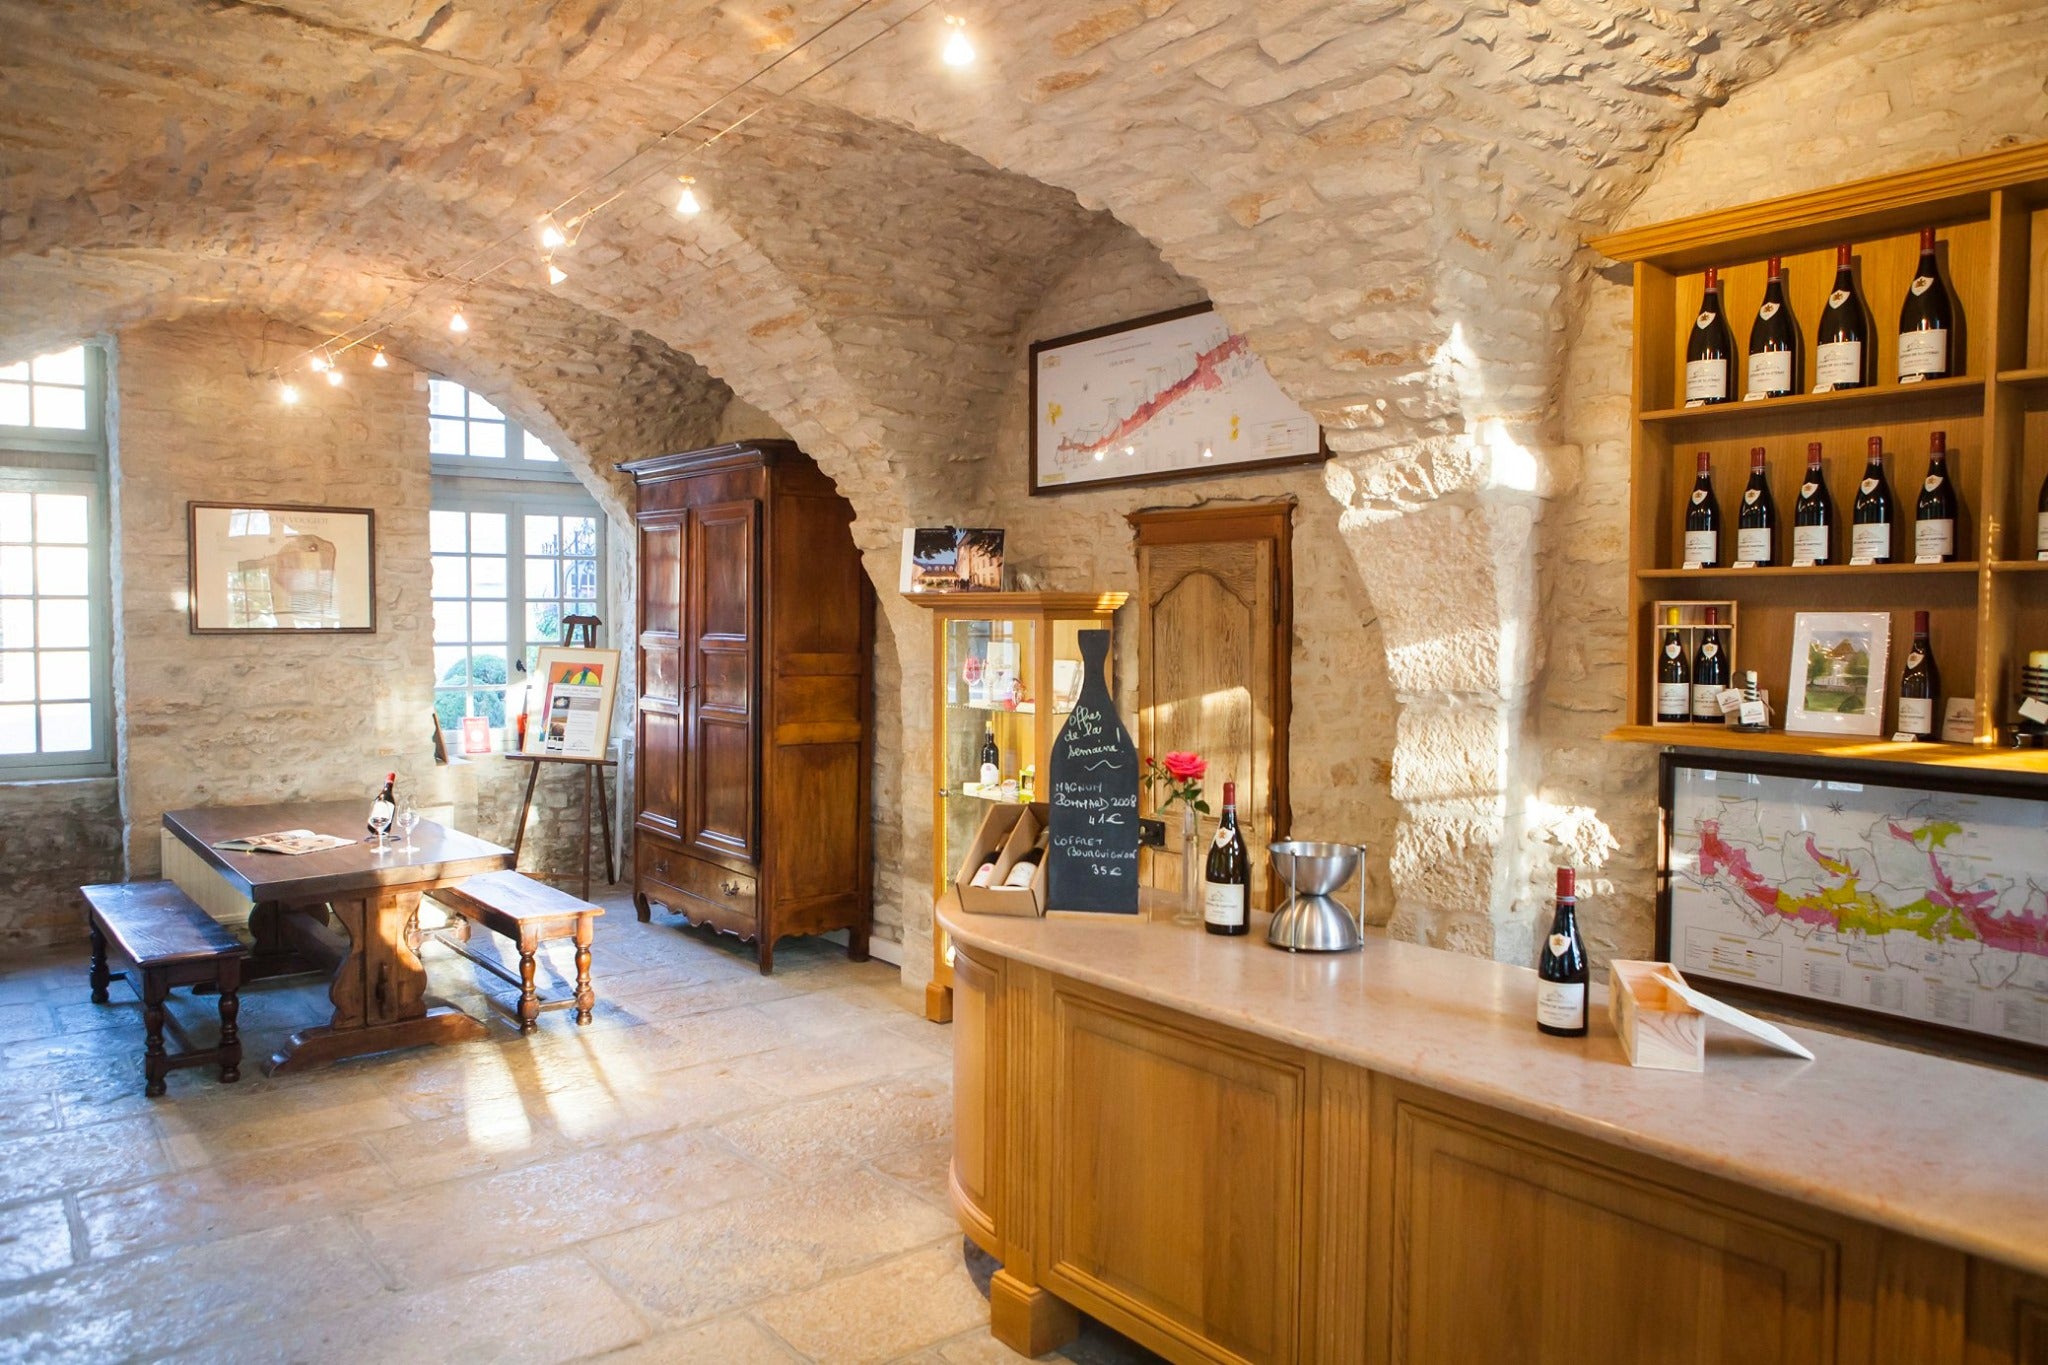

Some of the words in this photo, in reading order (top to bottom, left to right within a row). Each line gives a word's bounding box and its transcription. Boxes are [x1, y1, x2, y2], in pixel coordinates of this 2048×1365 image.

[1064, 730, 1080, 742] de
[1083, 722, 1102, 737] la
[1055, 782, 1103, 793] MAGNUM
[1054, 793, 1110, 811] POMMARD
[1111, 794, 1138, 808] 2008
[1054, 836, 1103, 846] COFFRET
[1067, 846, 1138, 859] BOURGUIGNON
